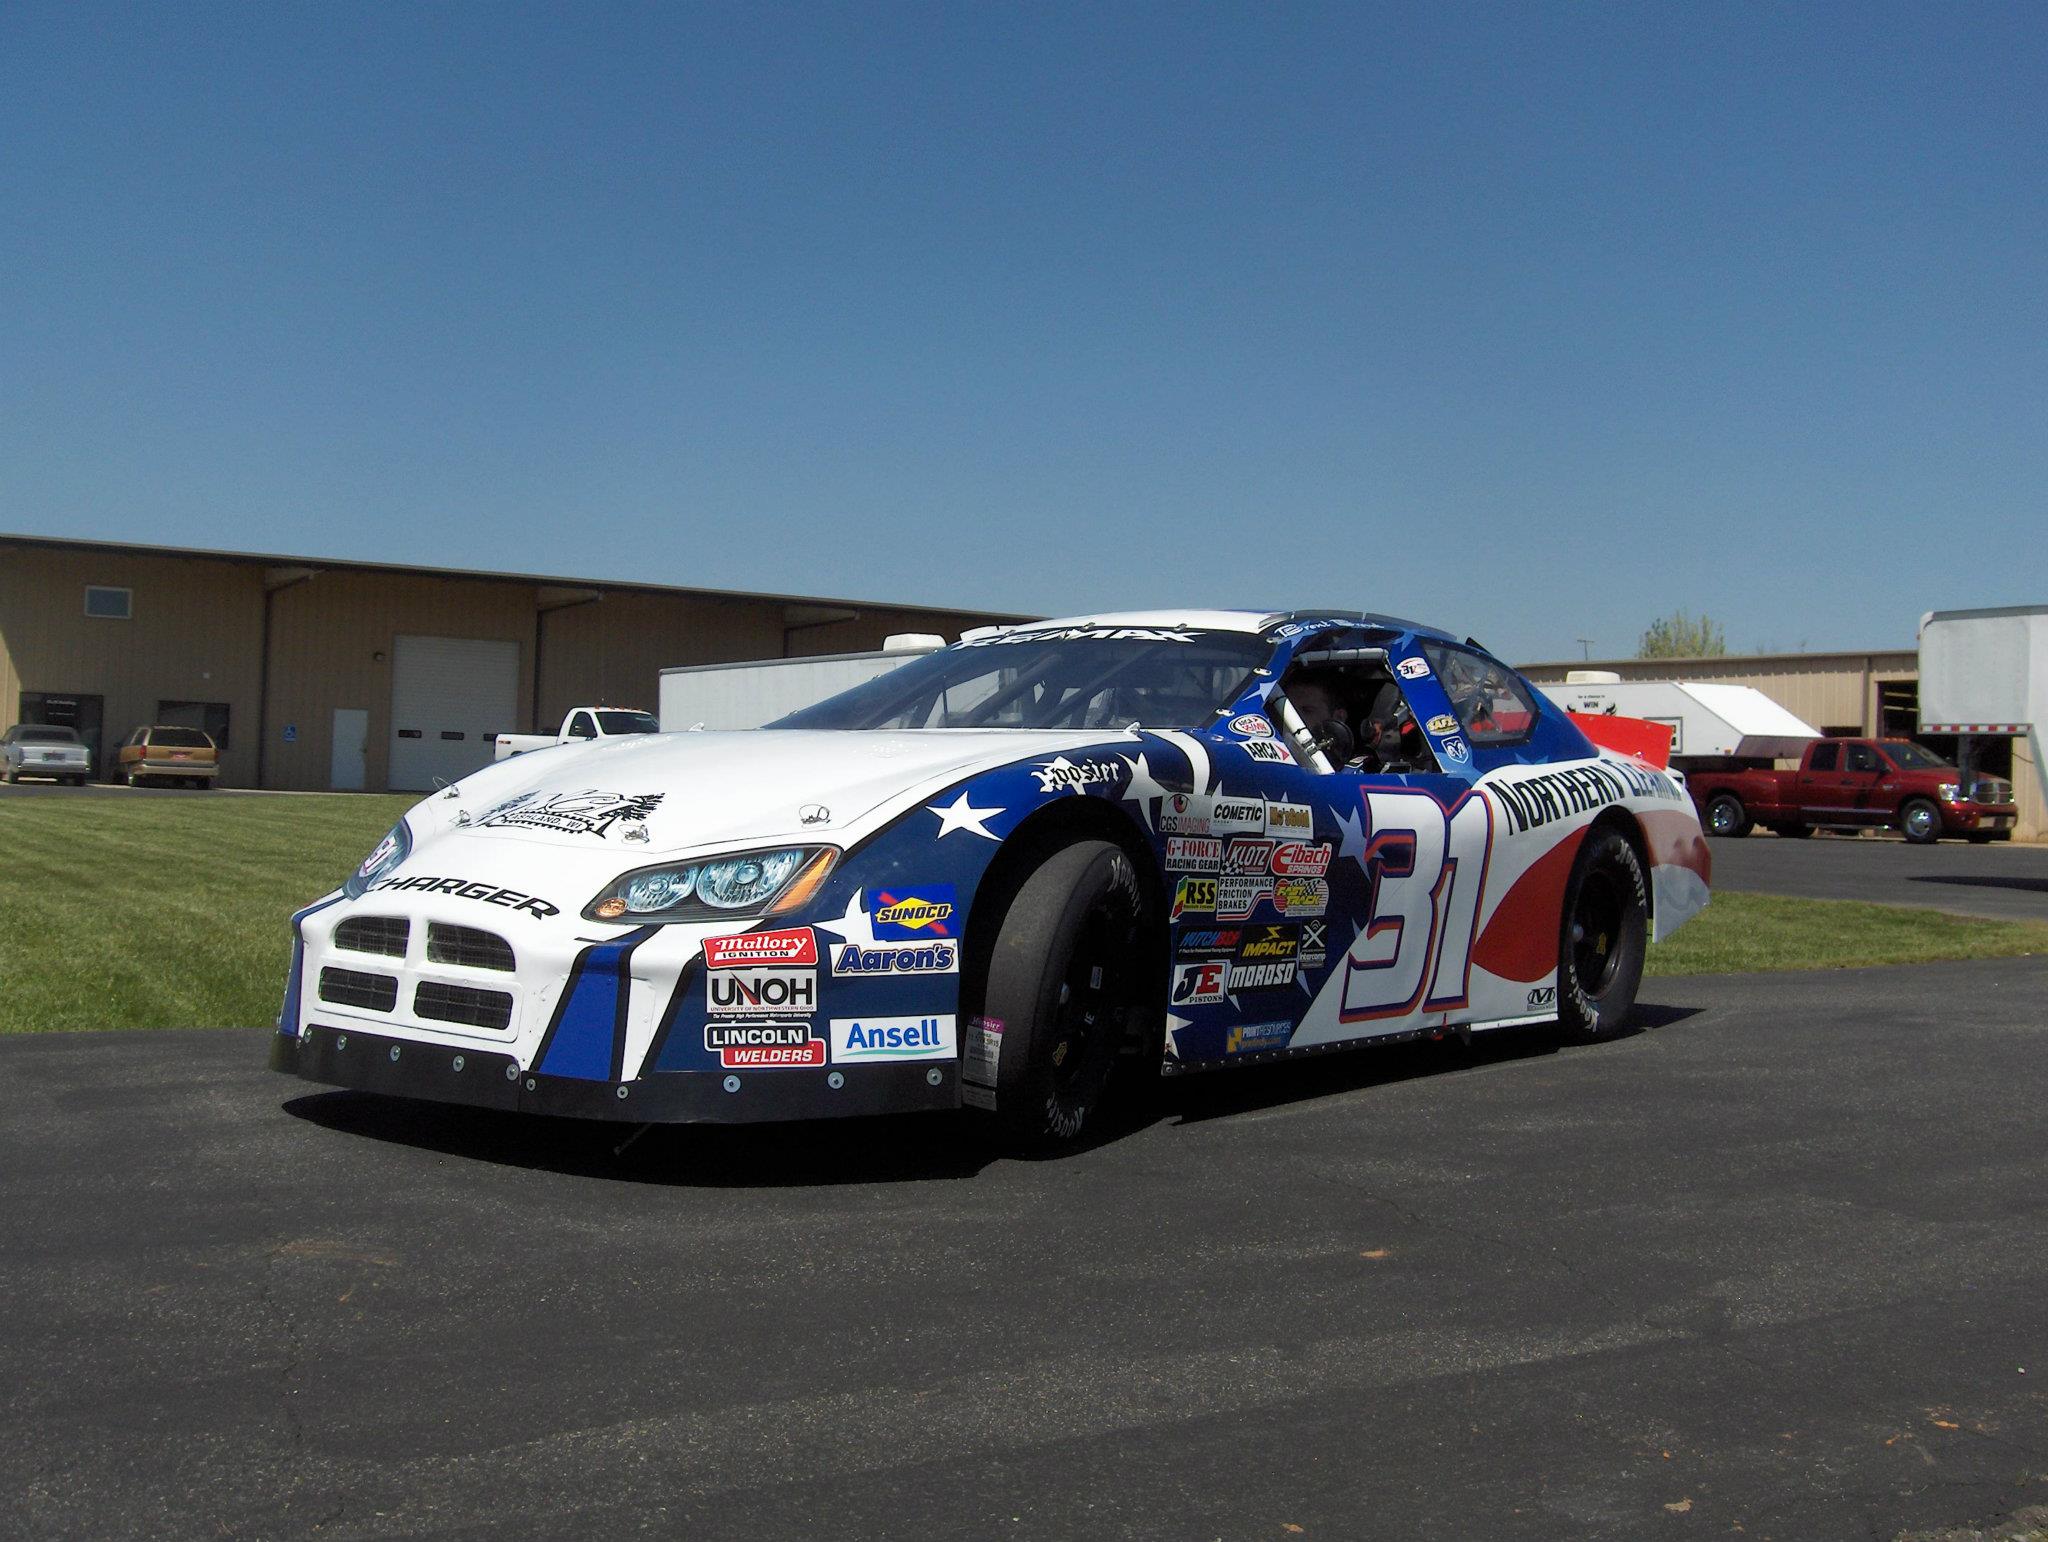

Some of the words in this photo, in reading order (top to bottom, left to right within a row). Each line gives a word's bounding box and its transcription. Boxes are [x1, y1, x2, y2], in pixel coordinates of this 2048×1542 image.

[1246, 742, 1281, 760] ARCA
[1485, 762, 1625, 836] NORTHERN
[1213, 803, 1263, 822] COMETIC
[1167, 838, 1220, 858] G-FORCE
[1228, 845, 1270, 867] KLOTZ
[1166, 858, 1197, 871] RACING
[1198, 859, 1219, 872] GEAR
[1271, 842, 1331, 873] Eibach
[1286, 865, 1323, 875] SPRINGS
[1219, 877, 1273, 888] PERFORMANCE
[1185, 881, 1216, 905] RSS
[1219, 889, 1253, 899] FRICTION
[878, 905, 950, 921] SUNOCO
[1218, 899, 1248, 910] BRAKES
[1340, 785, 1494, 1024] 31
[715, 934, 808, 951] Mallory
[1242, 940, 1296, 957] IMPACT
[723, 950, 790, 958] IGNITION
[836, 944, 955, 972] Aaron's
[1173, 964, 1223, 1003] JE
[1228, 963, 1296, 989] MOROSO
[711, 975, 813, 1006] UNOH
[1188, 995, 1223, 1003] PISTONS
[712, 1028, 804, 1046] LINCOLN
[846, 1018, 941, 1049] Ansell
[733, 1049, 815, 1064] WELDERS
